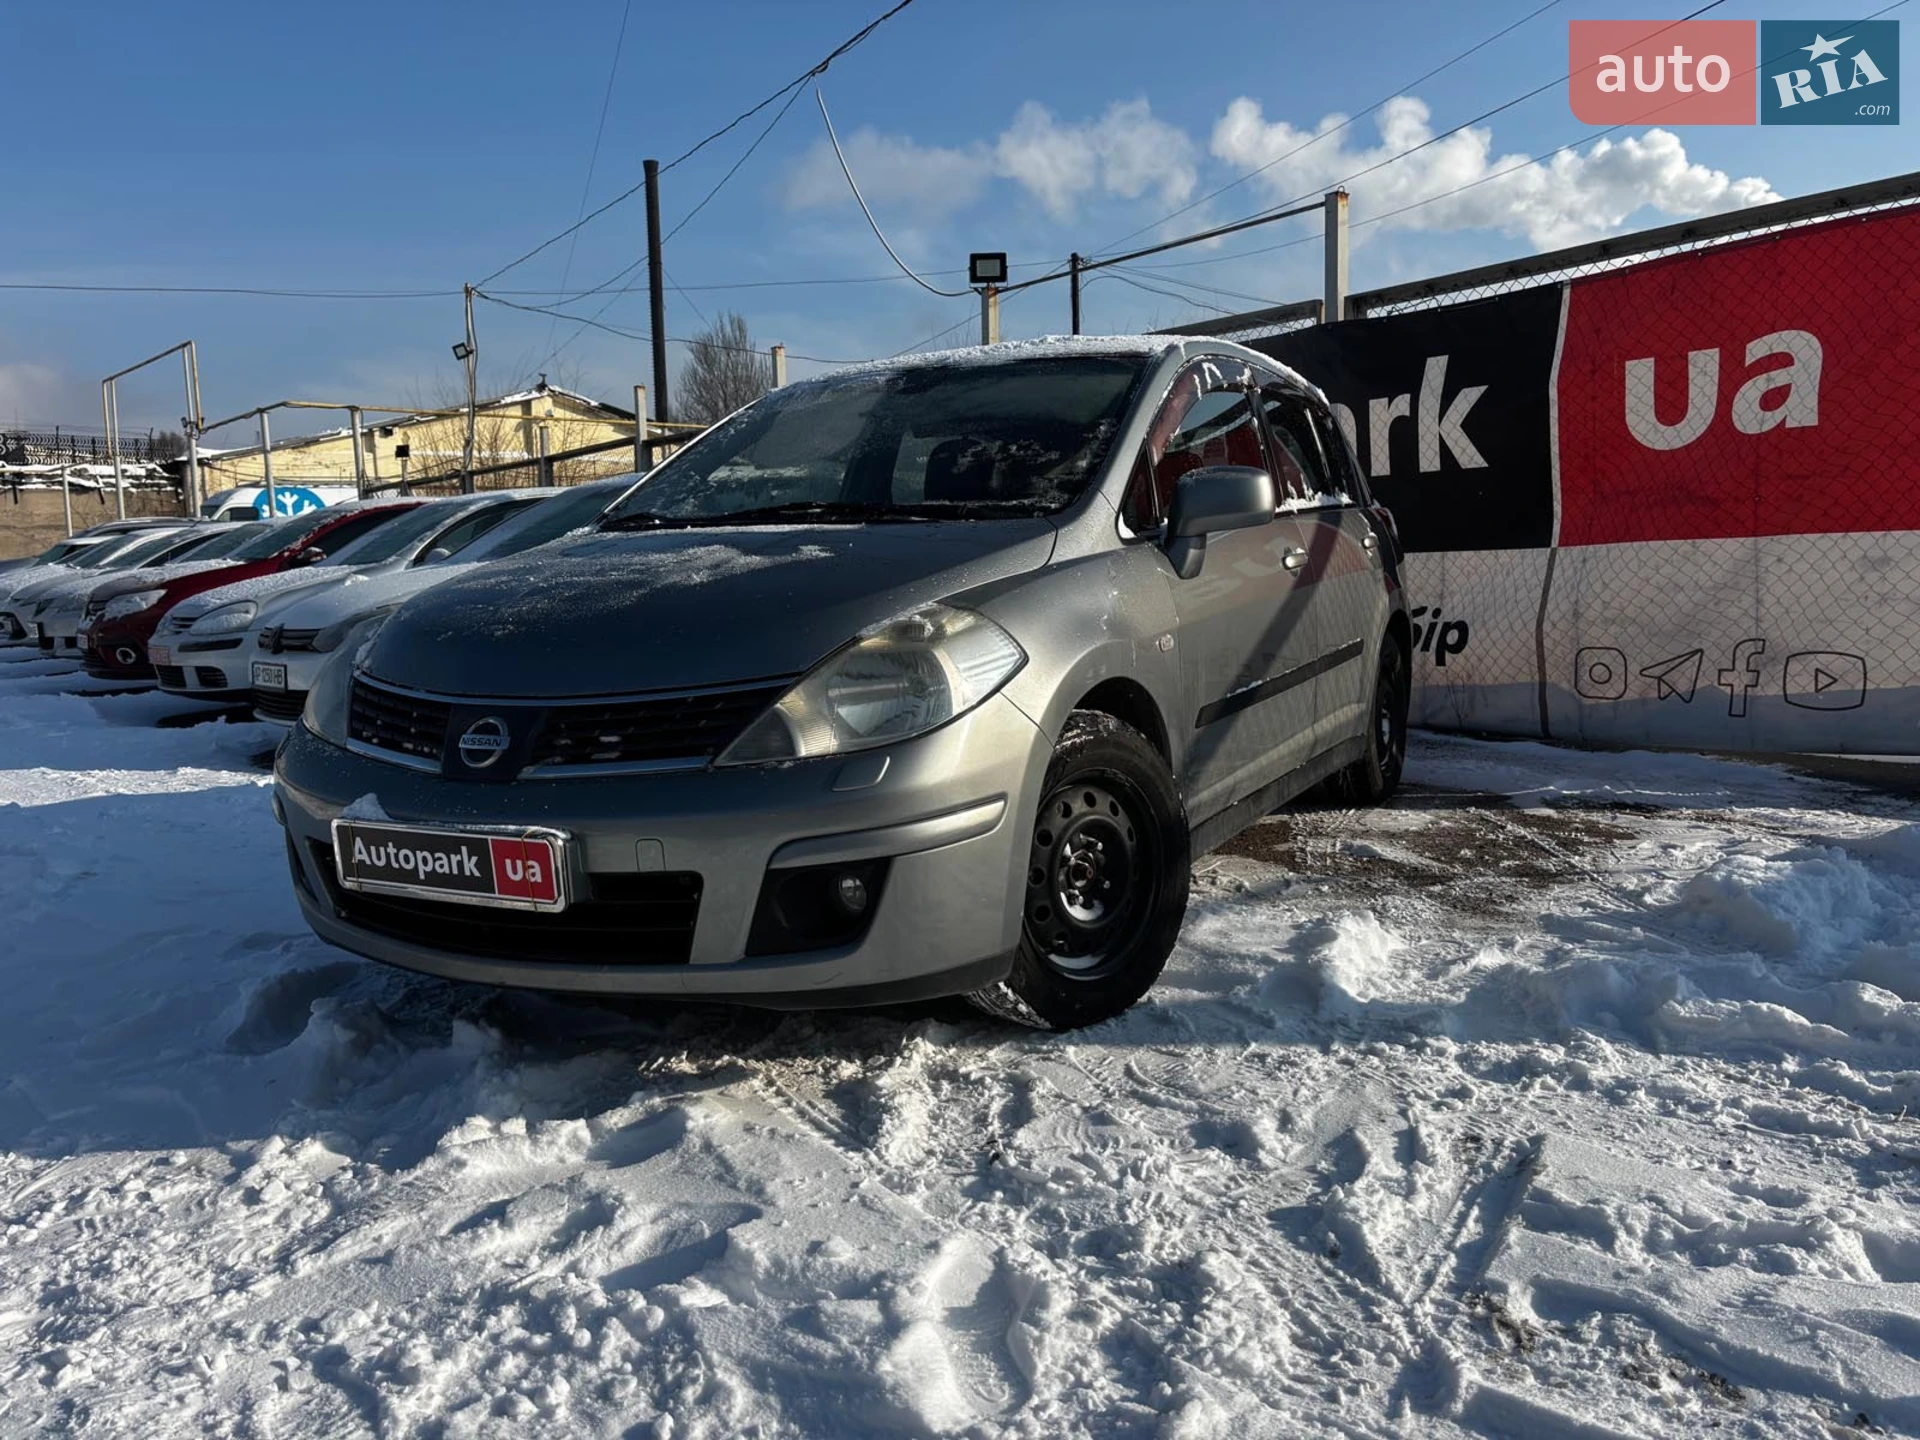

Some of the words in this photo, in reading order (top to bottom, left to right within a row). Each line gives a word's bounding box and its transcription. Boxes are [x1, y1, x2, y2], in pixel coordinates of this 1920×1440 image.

[1625, 329, 1823, 451] ua
[461, 736, 503, 748] NISSAN
[352, 836, 481, 880] Autopark
[505, 859, 542, 883] ua
